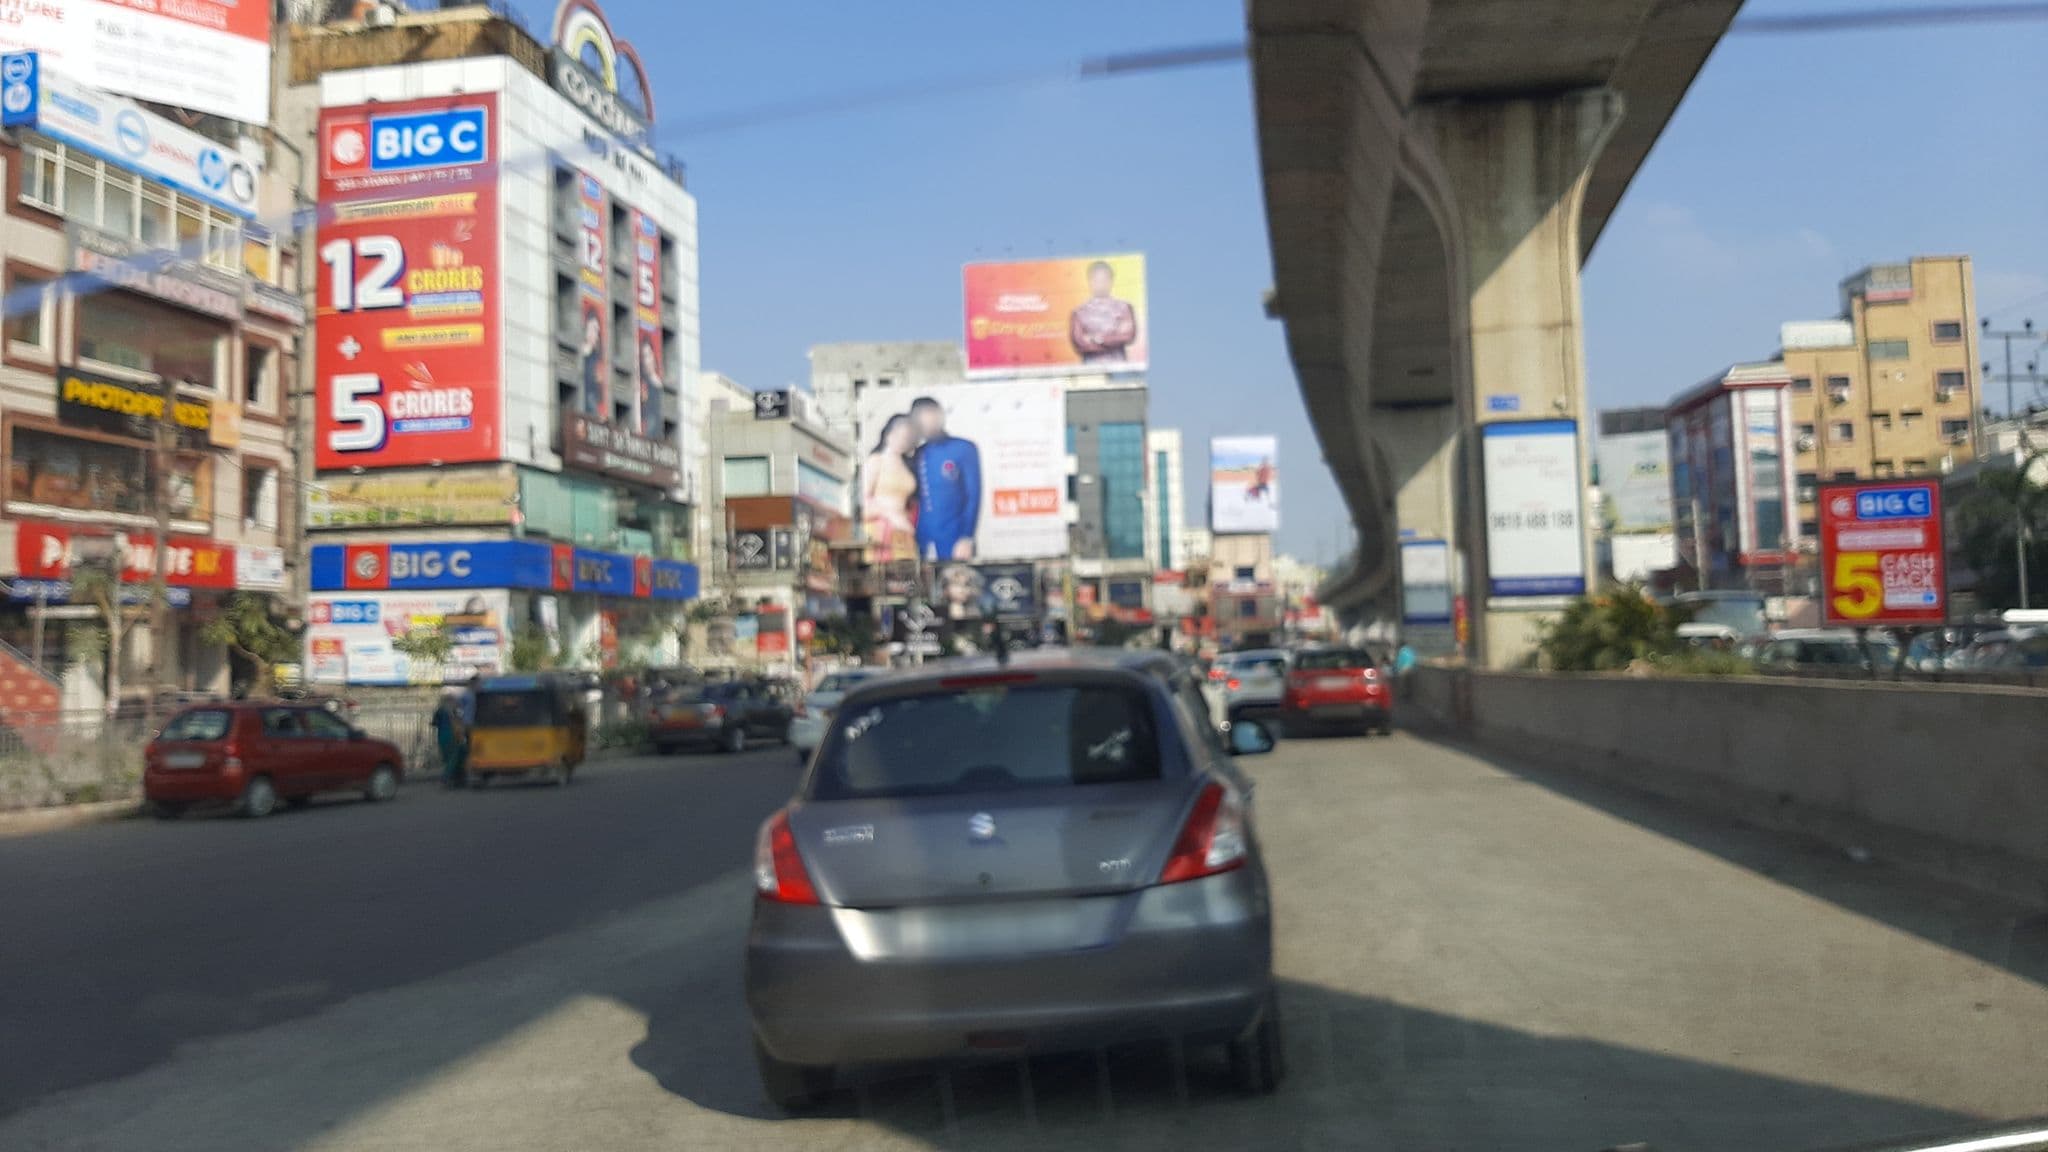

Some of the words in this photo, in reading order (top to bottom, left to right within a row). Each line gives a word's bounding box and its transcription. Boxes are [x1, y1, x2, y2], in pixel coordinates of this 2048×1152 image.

[376, 124, 444, 161] BIG
[450, 120, 478, 153] C
[578, 229, 604, 275] 12
[320, 234, 407, 312] 12
[409, 266, 484, 293] CRORES
[638, 264, 656, 307] 5
[328, 373, 388, 452] 5
[389, 387, 474, 419] CRORES
[1859, 493, 1905, 516] BIG
[1907, 492, 1926, 514] C
[390, 551, 445, 579] BIG
[449, 549, 472, 578] C
[1833, 551, 1883, 619] 5
[1881, 552, 1935, 571] CASH
[333, 604, 365, 619] BIG
[365, 604, 379, 618] C
